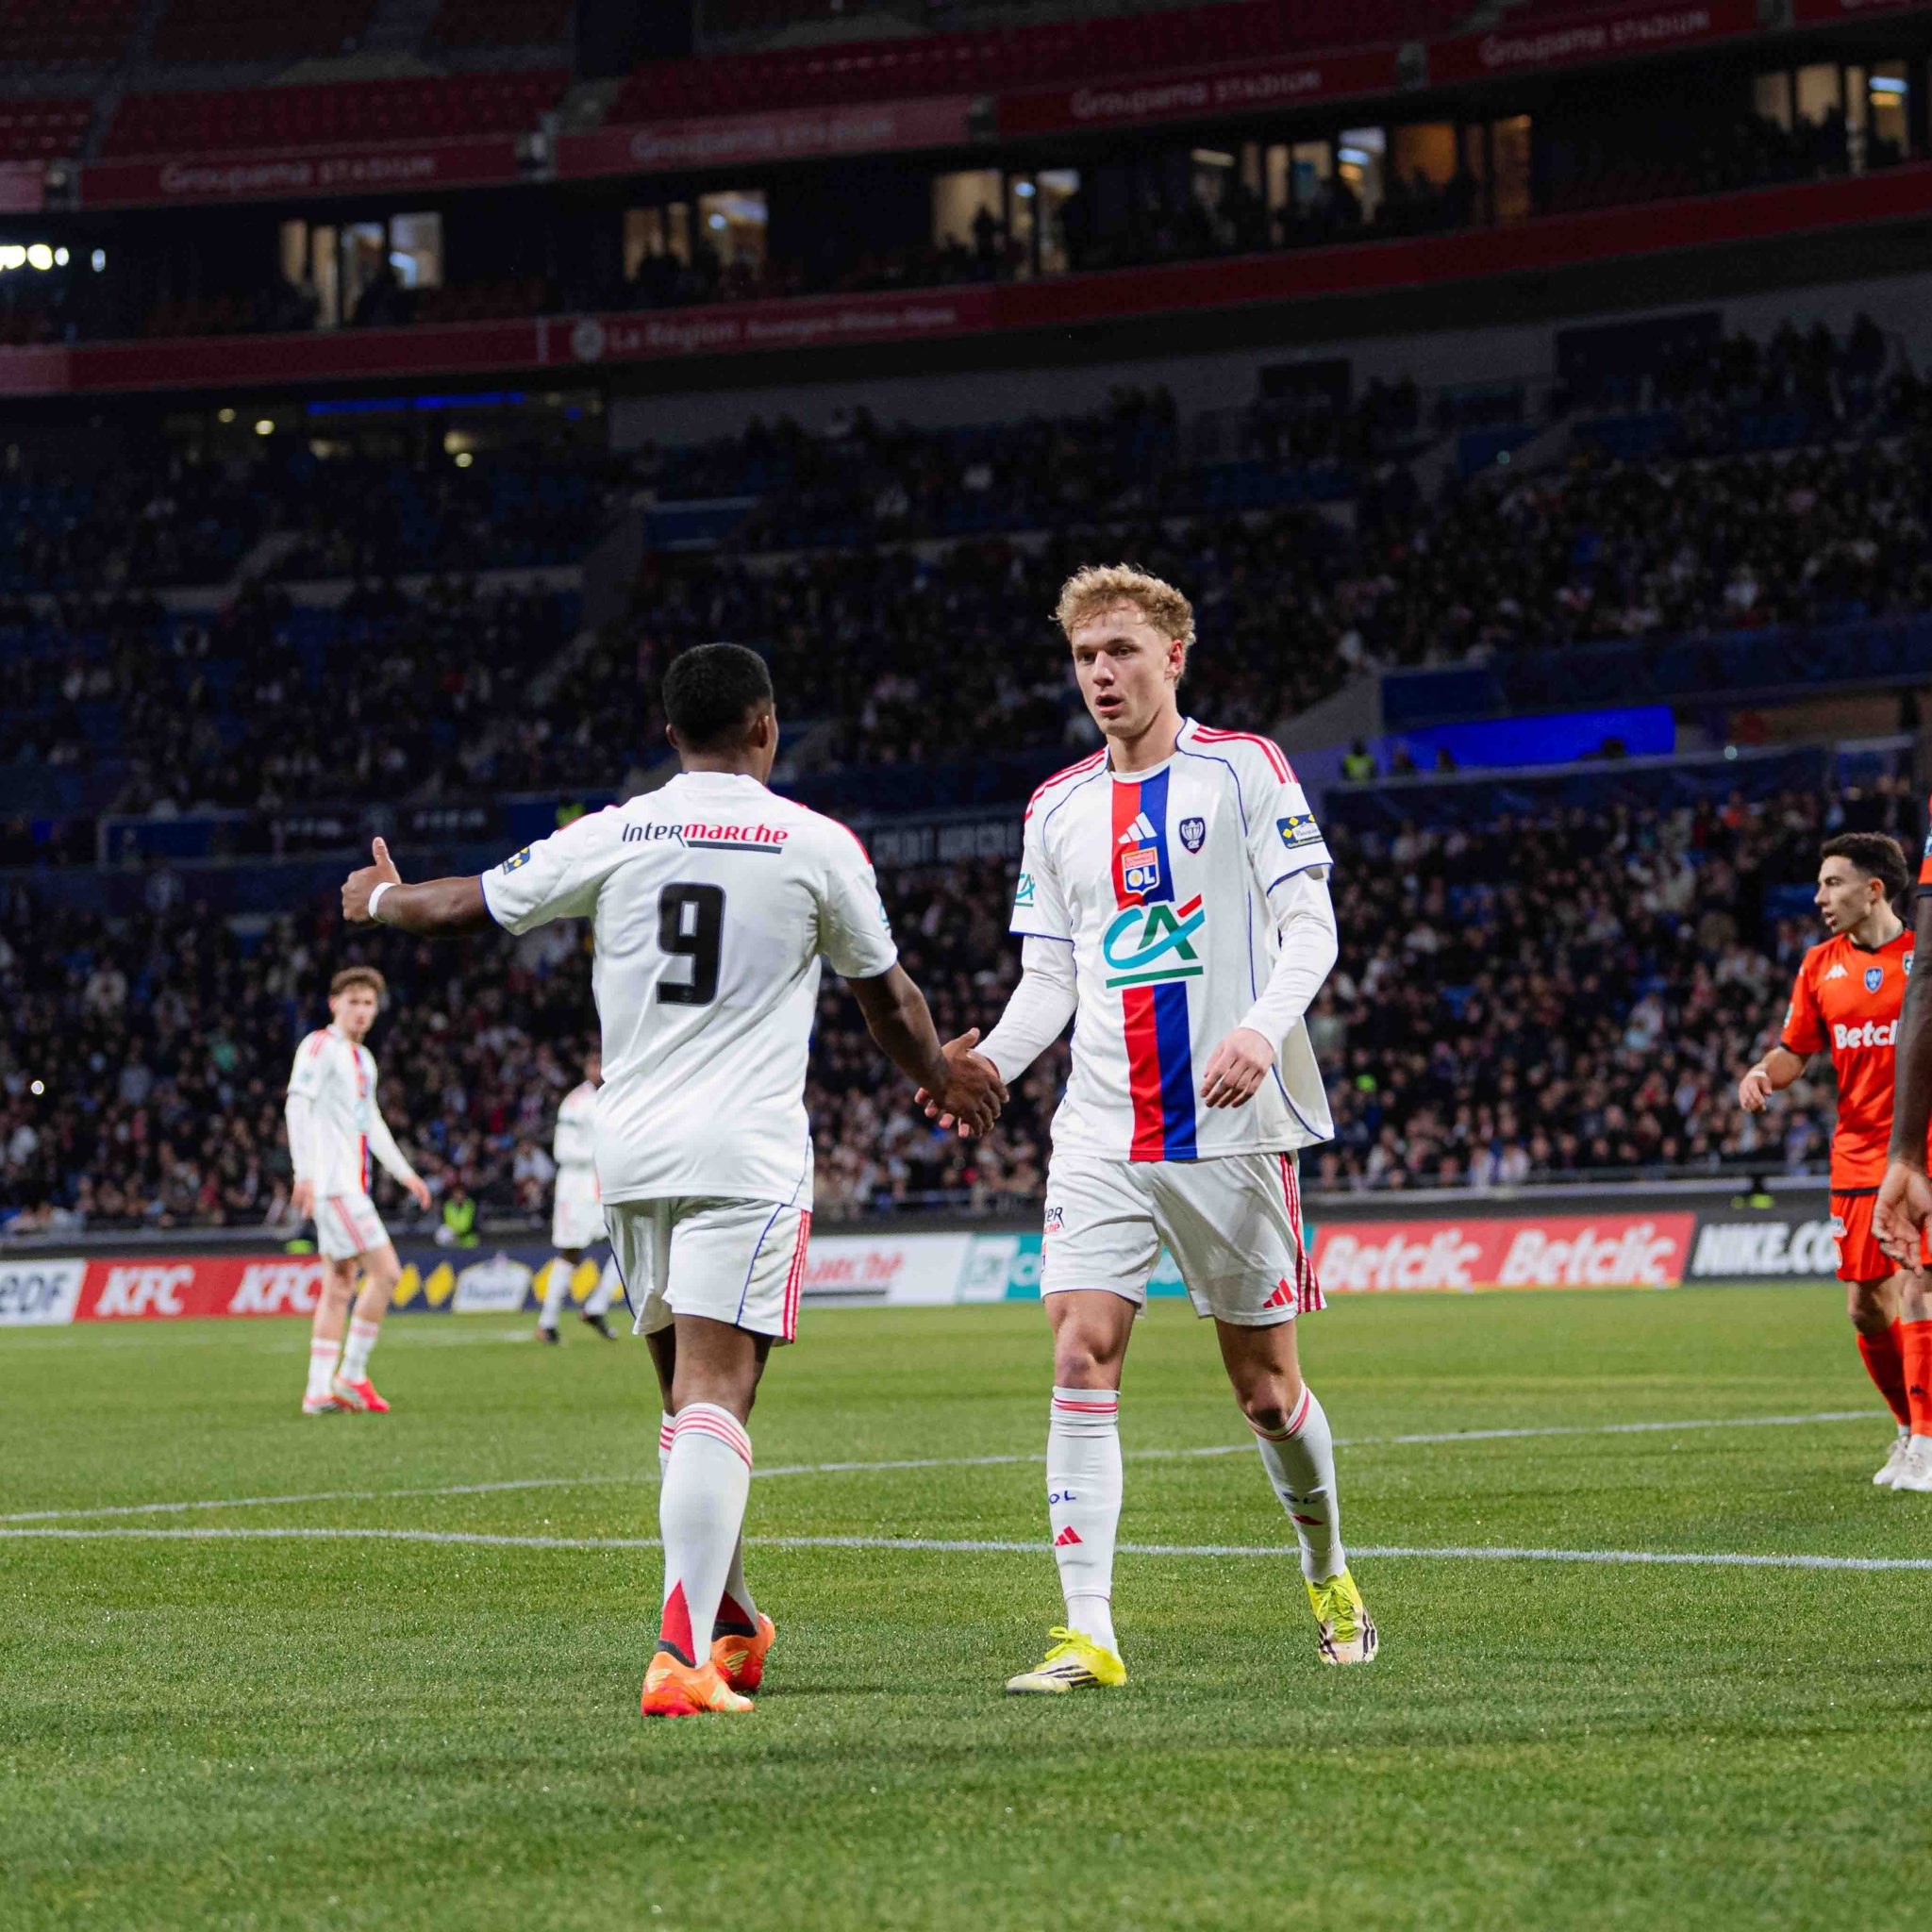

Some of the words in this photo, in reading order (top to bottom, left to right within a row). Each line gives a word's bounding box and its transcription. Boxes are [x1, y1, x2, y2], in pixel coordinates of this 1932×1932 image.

[1127, 866, 1156, 888] OL
[656, 882, 726, 1008] 9
[1319, 1228, 1482, 1290] Betclic
[1499, 1223, 1676, 1286] Betclic
[95, 1264, 195, 1315] KFC
[228, 1263, 324, 1313] KFC
[1049, 1491, 1076, 1504] OL
